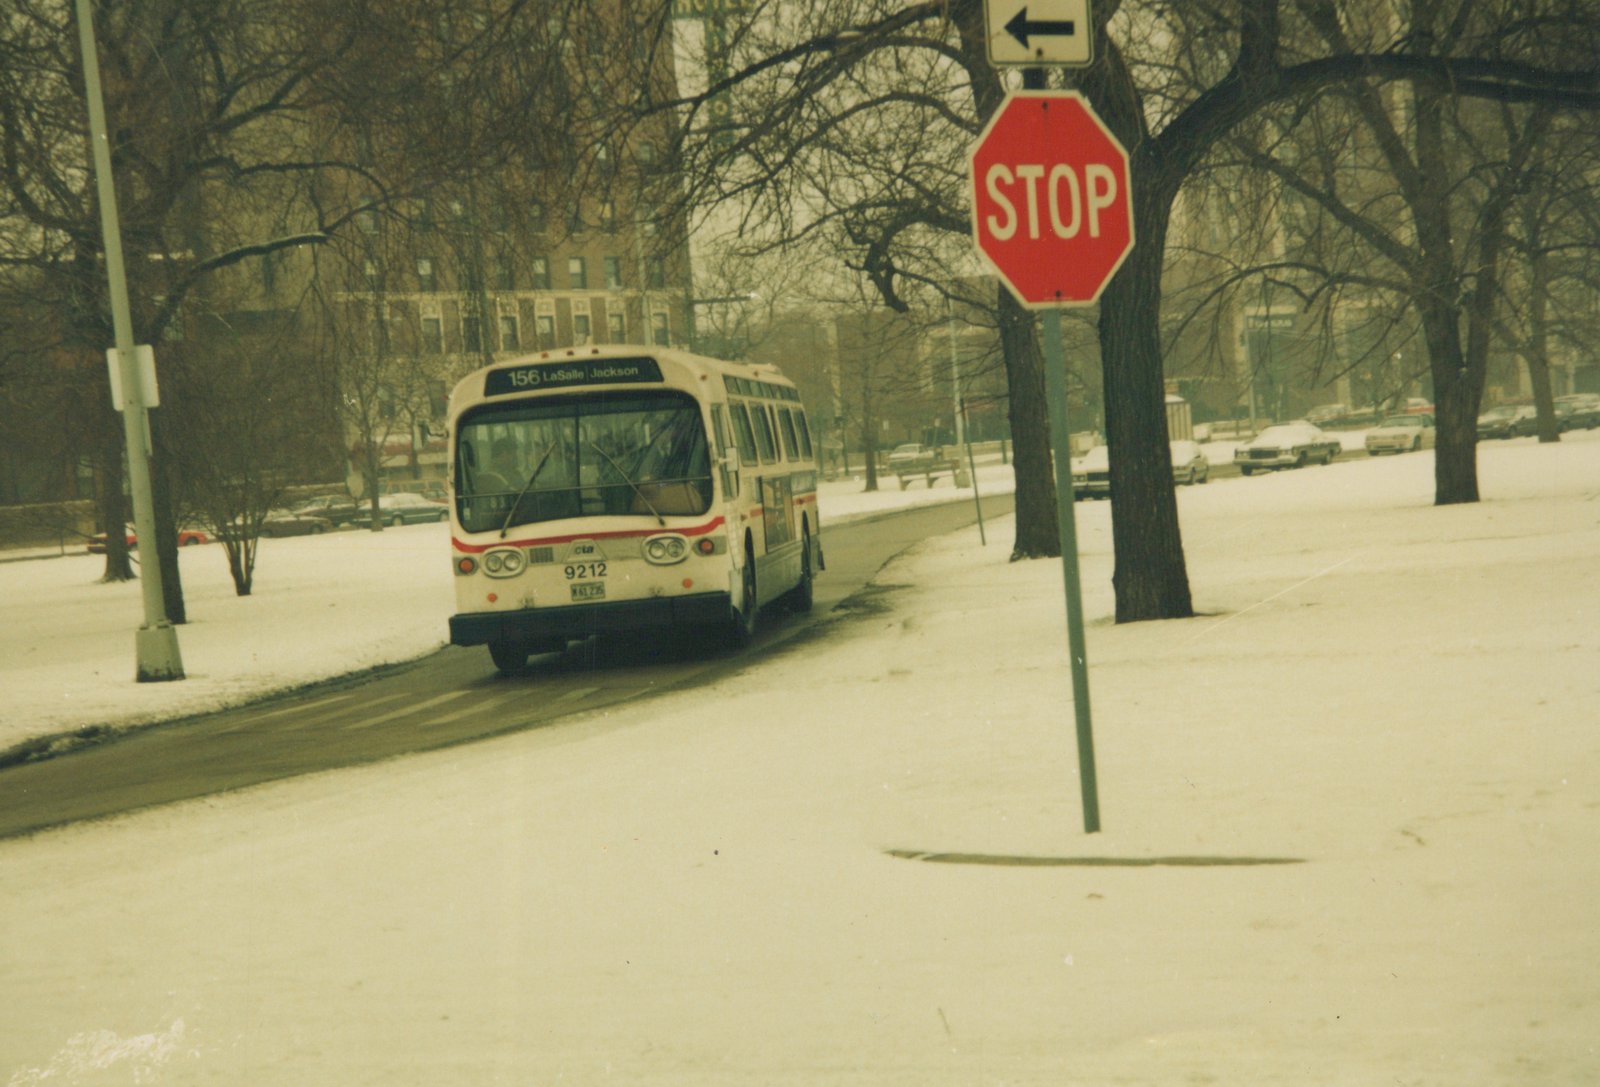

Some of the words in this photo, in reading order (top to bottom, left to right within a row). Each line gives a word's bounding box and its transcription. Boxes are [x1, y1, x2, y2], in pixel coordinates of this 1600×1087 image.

[986, 163, 1118, 241] STOP
[508, 370, 540, 386] 156
[543, 370, 585, 381] LaSalle
[590, 366, 639, 378] Jackson
[564, 563, 608, 580] 9212
